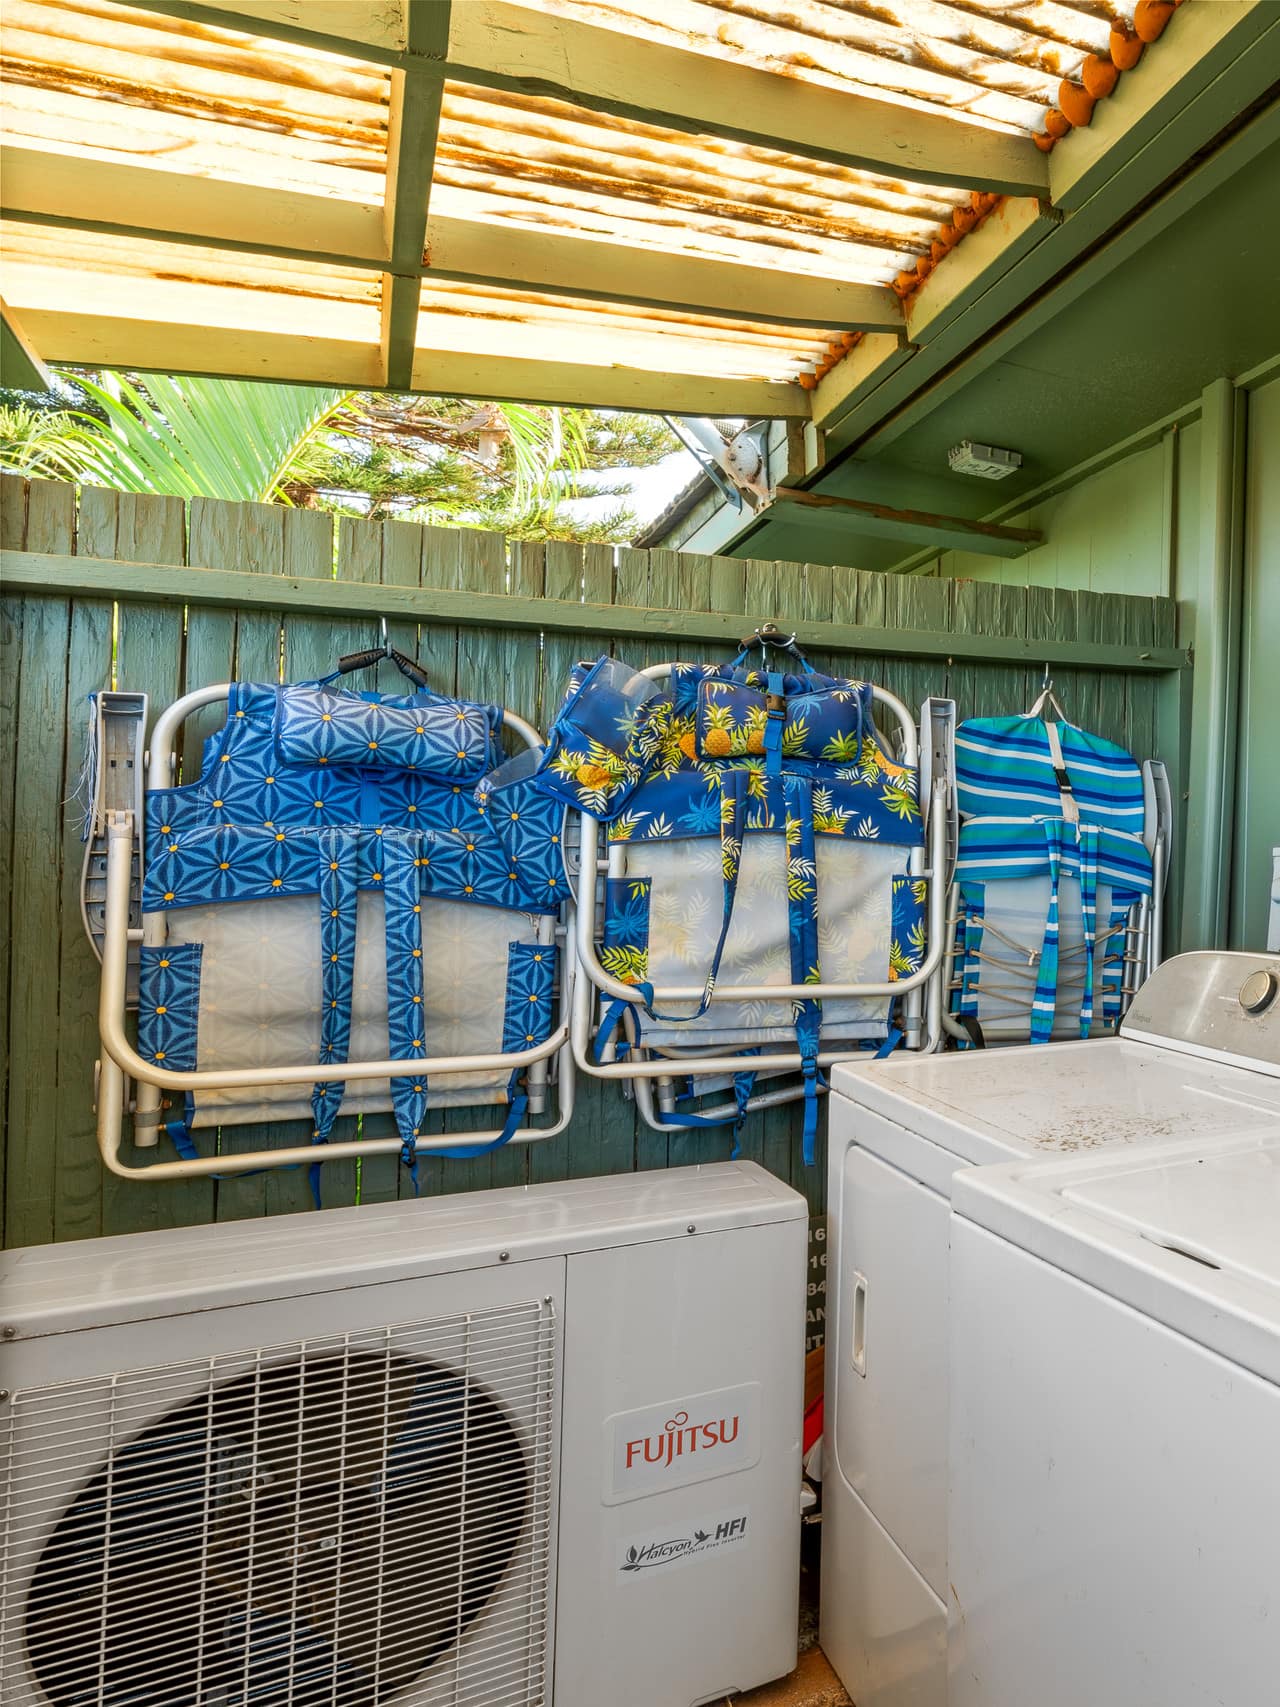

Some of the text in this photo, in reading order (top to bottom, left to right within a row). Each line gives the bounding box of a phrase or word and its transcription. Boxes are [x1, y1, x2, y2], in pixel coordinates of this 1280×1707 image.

[625, 1415, 739, 1469] FUJITSU
[715, 1516, 747, 1540] HFI
[637, 1541, 691, 1563] Halcyon
